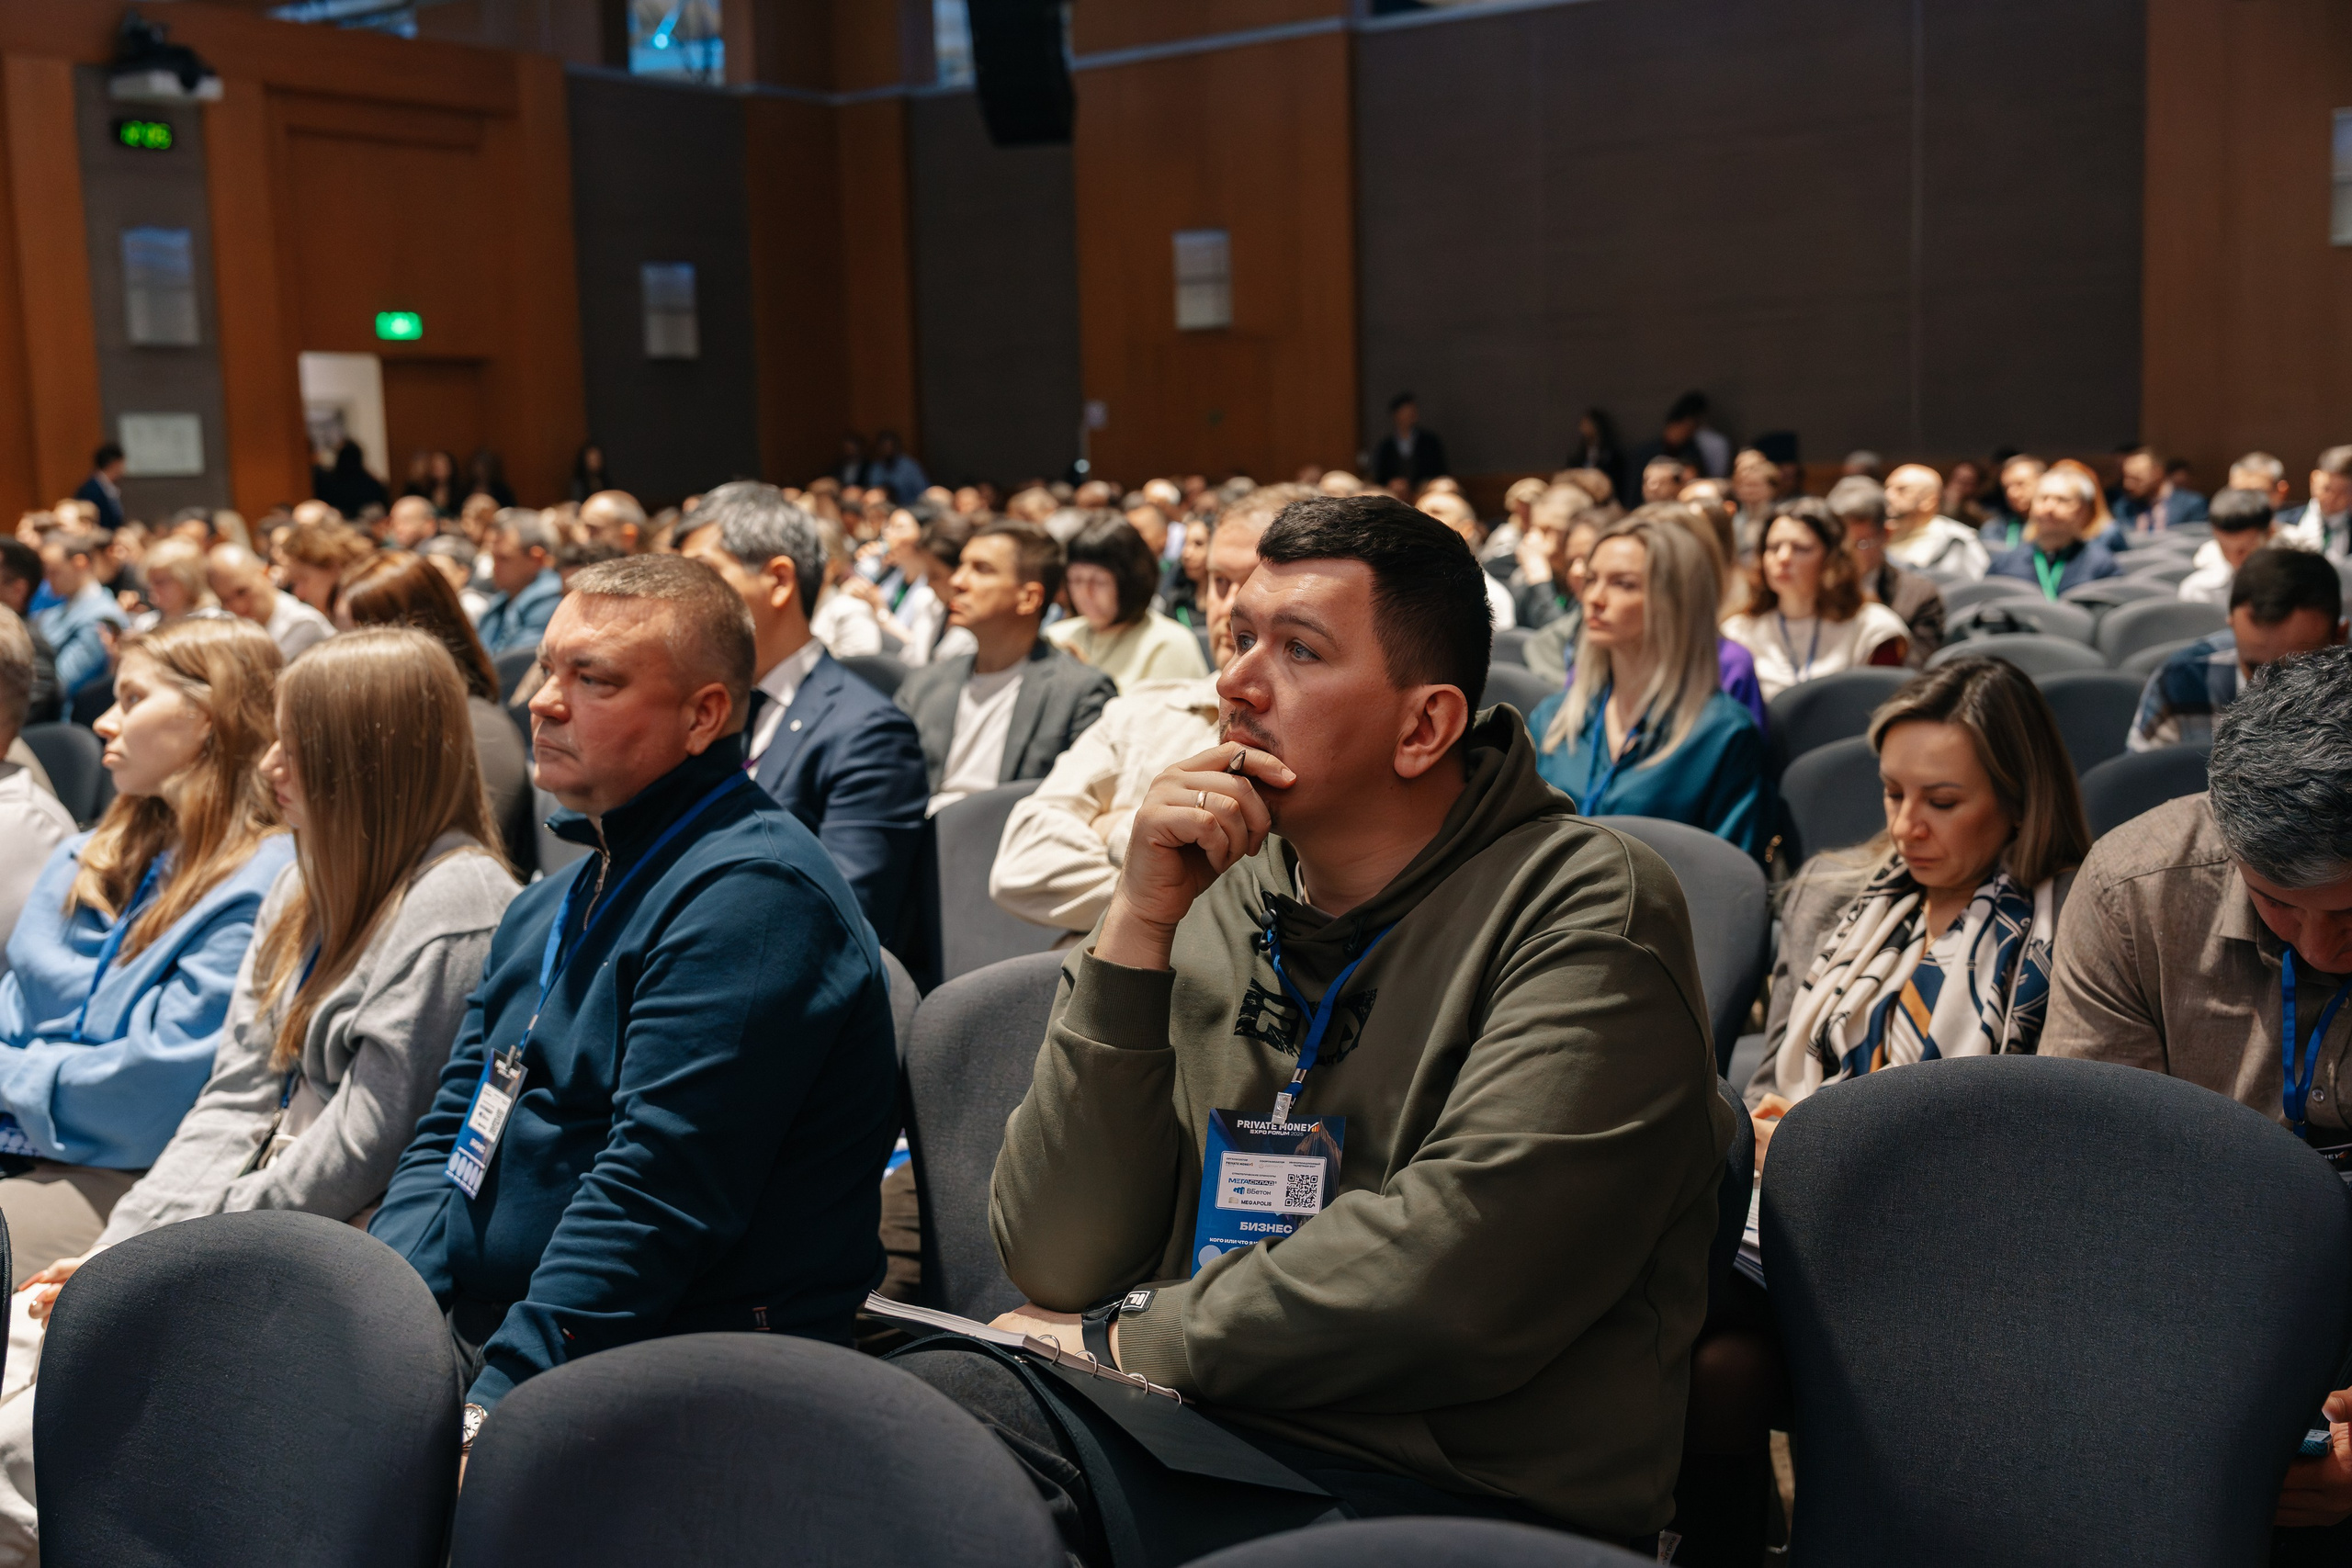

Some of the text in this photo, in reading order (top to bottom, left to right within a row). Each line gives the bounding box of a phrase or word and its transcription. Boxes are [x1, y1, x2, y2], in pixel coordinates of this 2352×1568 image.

[1237, 1119, 1315, 1132] PRIVATE MONEY
[1239, 1221, 1293, 1234] БИЗНЕС
